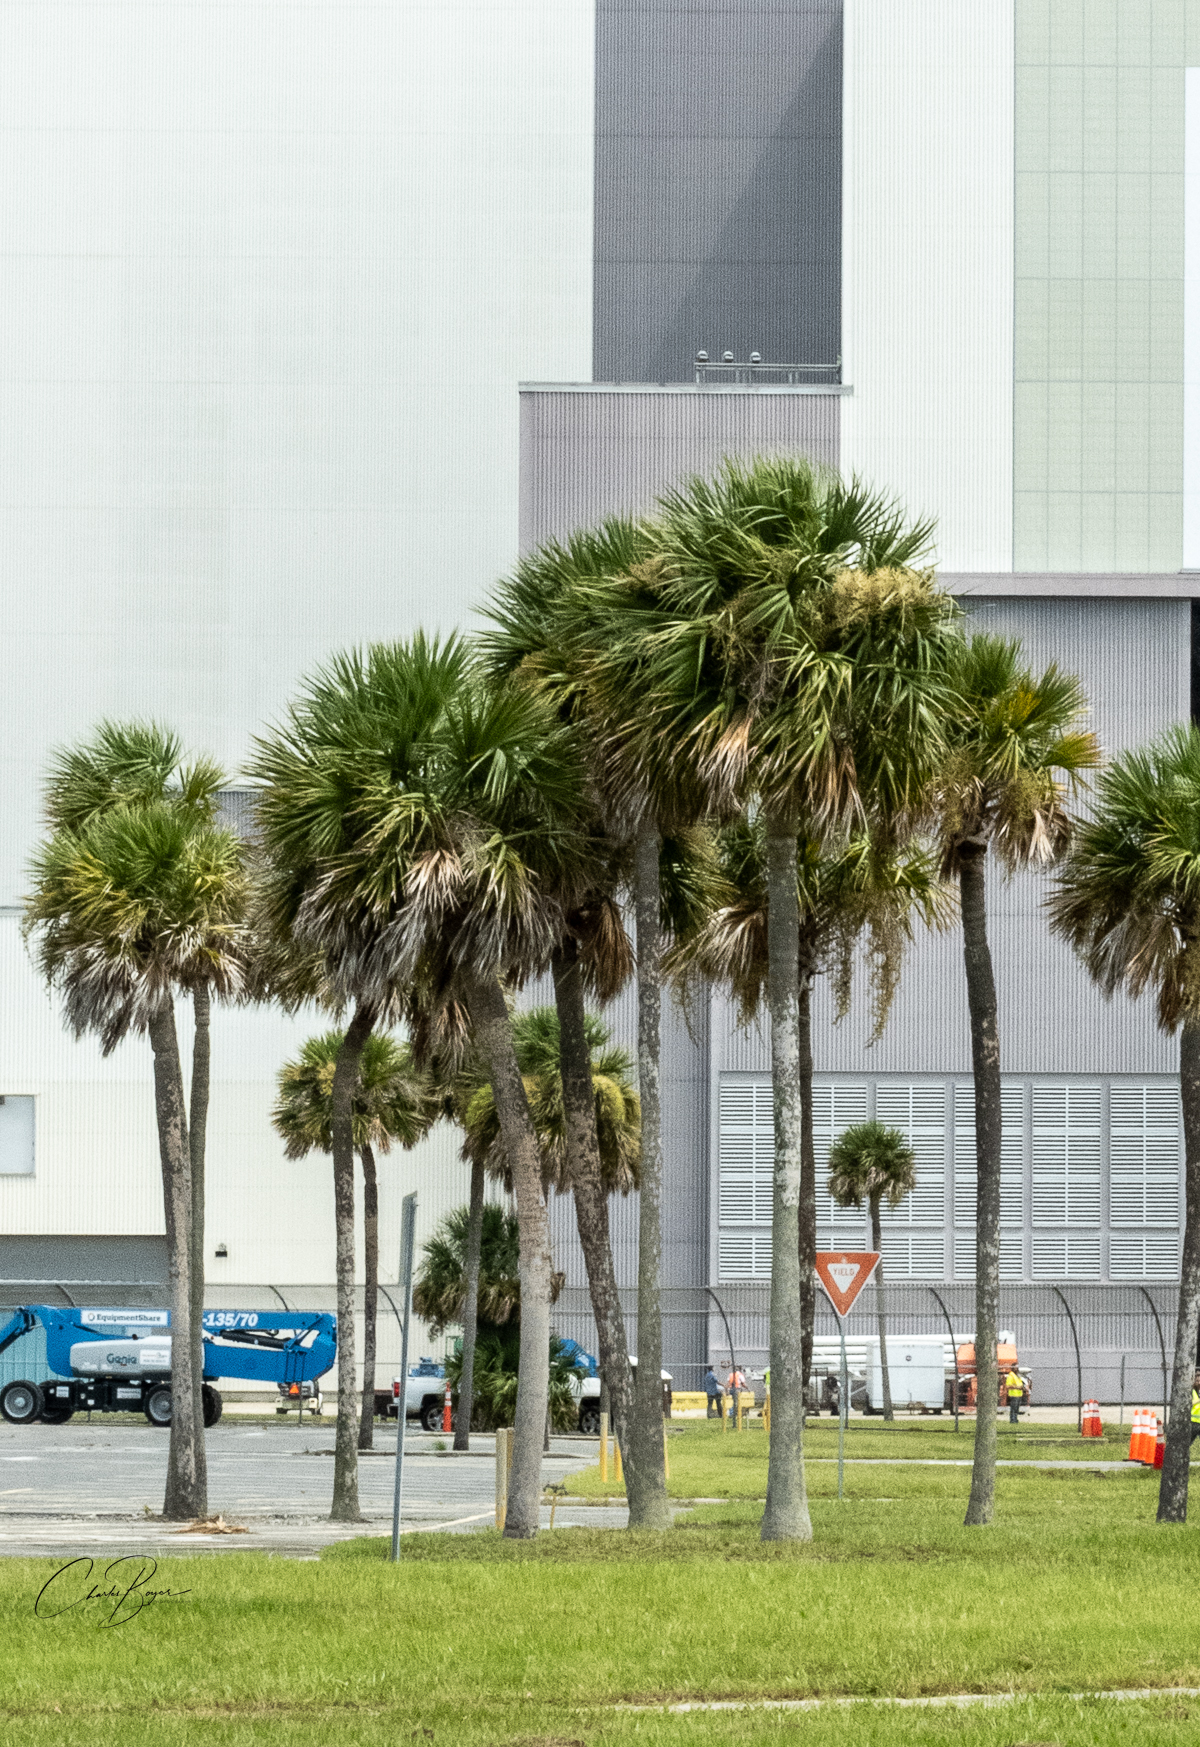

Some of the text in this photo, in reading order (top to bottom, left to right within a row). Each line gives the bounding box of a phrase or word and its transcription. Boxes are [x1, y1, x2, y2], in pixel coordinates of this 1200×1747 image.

[833, 1268, 854, 1276] YIELD
[96, 1313, 161, 1322] EquipmentShare
[106, 1352, 138, 1365] Genie
